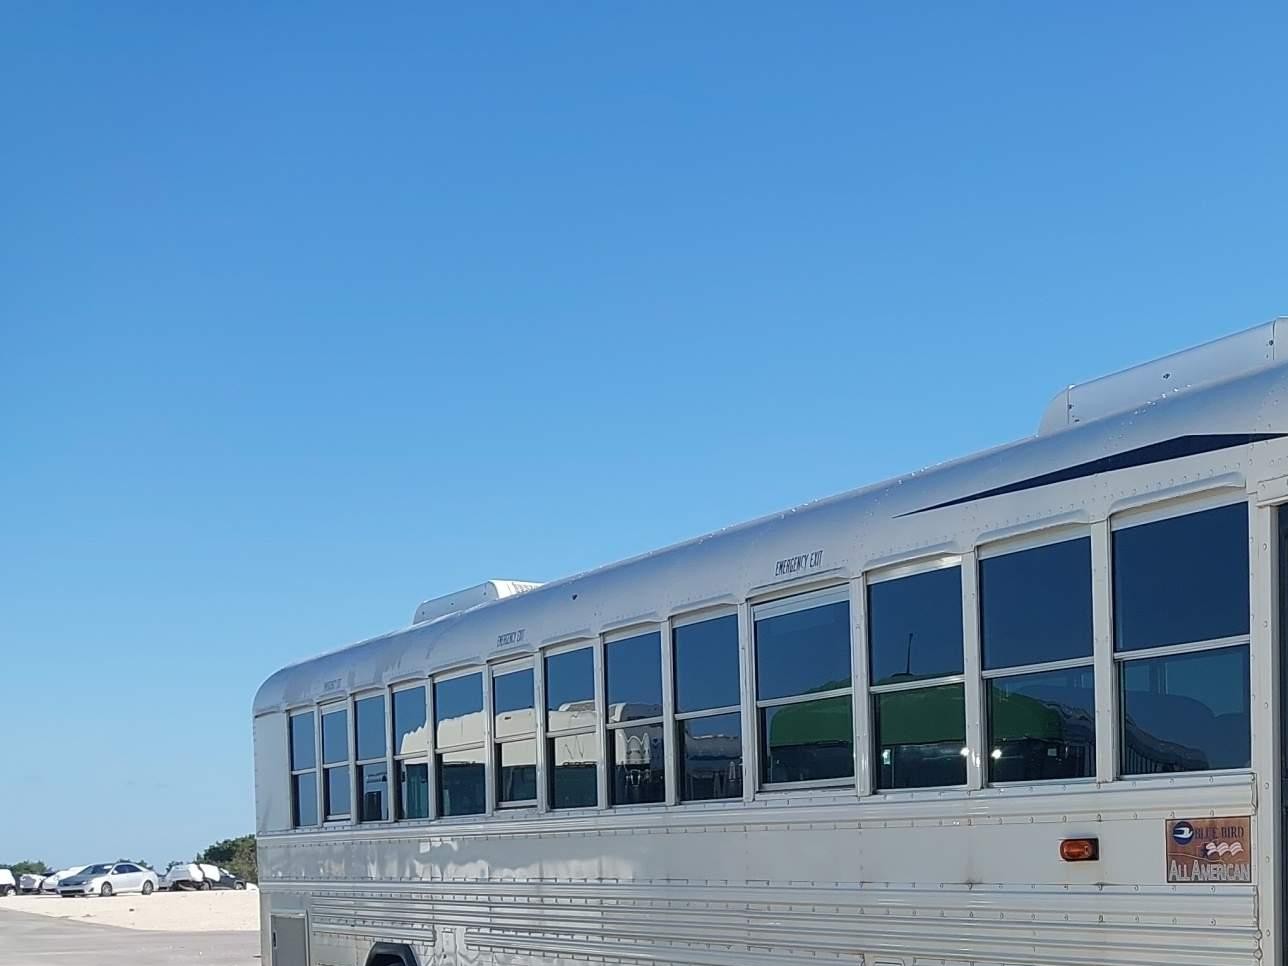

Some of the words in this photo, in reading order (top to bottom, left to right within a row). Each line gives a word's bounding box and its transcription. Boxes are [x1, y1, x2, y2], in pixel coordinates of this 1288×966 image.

[775, 553, 809, 576] EMERGENCY
[809, 550, 823, 568] EXIT
[1195, 826, 1218, 839] BLUE
[1221, 826, 1244, 838] BIRD
[1192, 860, 1249, 881] AMERICAN
